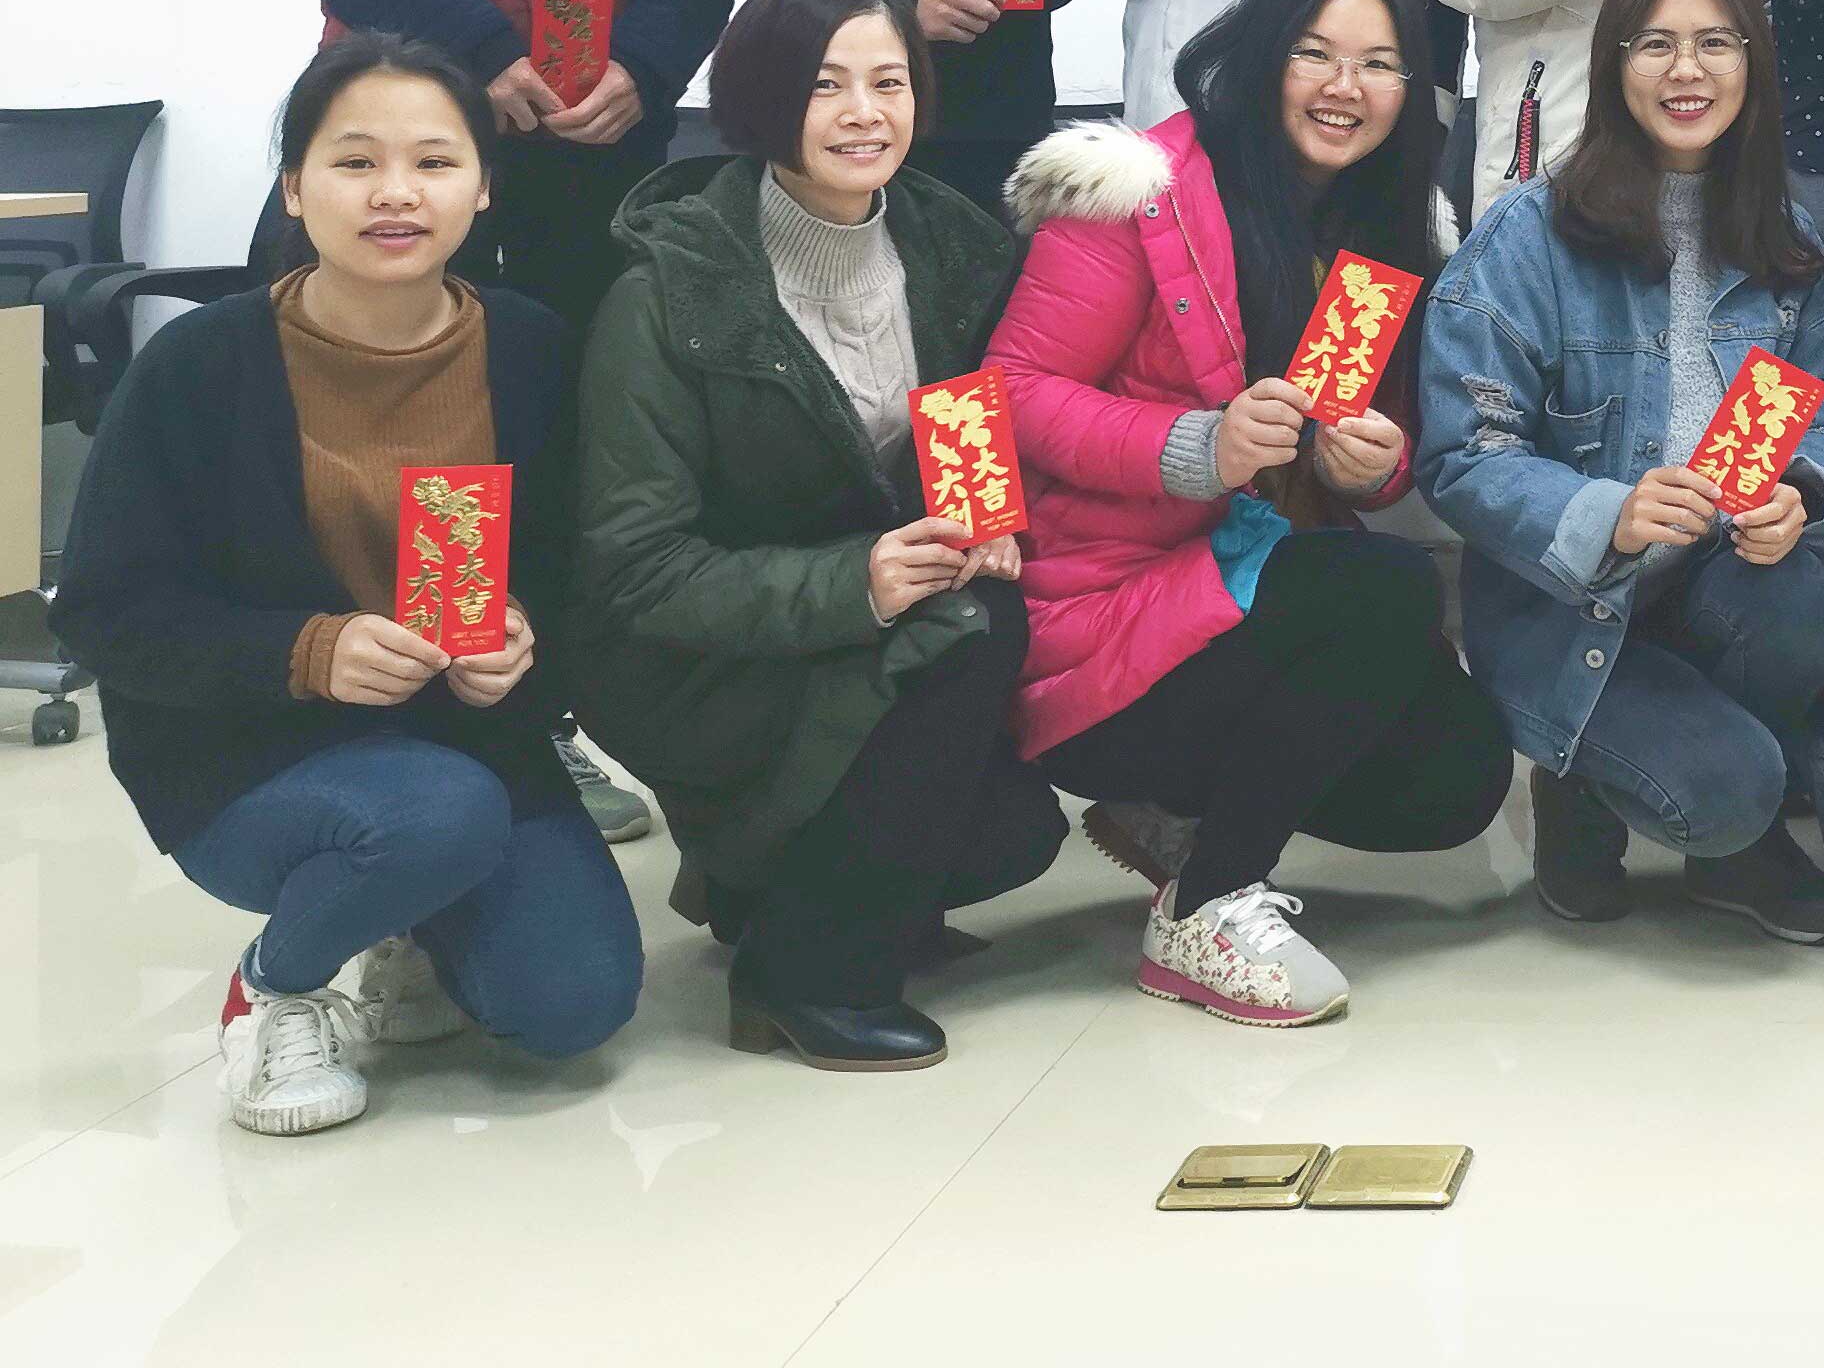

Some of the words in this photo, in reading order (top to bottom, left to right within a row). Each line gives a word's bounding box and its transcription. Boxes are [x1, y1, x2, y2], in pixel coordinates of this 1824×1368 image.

[1335, 338, 1375, 401] 大吉
[972, 447, 1010, 512] 大吉
[1737, 437, 1777, 496] 大吉
[452, 550, 494, 625] 大吉
